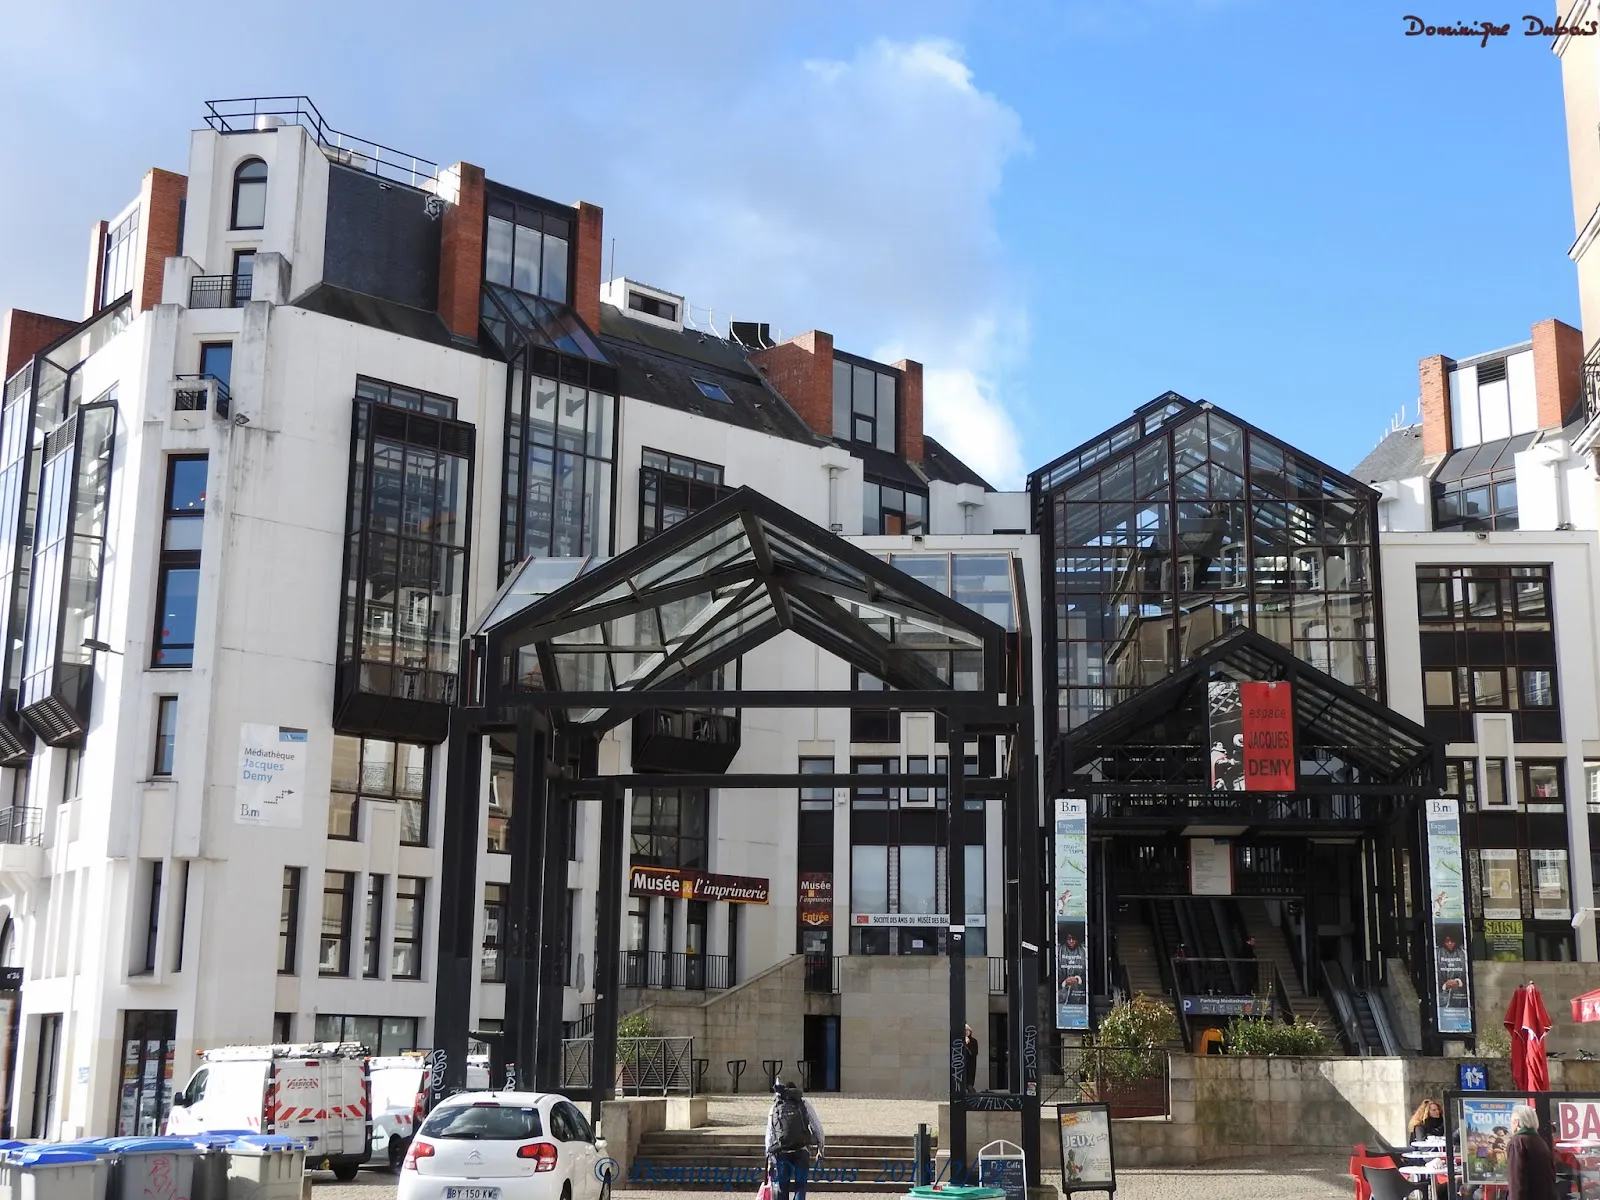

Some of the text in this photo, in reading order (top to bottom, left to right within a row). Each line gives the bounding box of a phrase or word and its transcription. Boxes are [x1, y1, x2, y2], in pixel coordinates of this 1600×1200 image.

[1249, 708, 1286, 721] espace
[1248, 731, 1290, 749] JACQUES
[244, 747, 295, 761] Médiathèque
[243, 758, 285, 771] Jacques
[1248, 759, 1291, 776] DEMY
[243, 770, 273, 784] Demy
[633, 872, 680, 892] Musée
[694, 878, 767, 900] l'imprimerie
[801, 881, 831, 890] Musée
[802, 912, 829, 921] Entrée
[1183, 1000, 1192, 1011] P
[1472, 1112, 1492, 1125] CRO
[1065, 1135, 1095, 1148] JEUX
